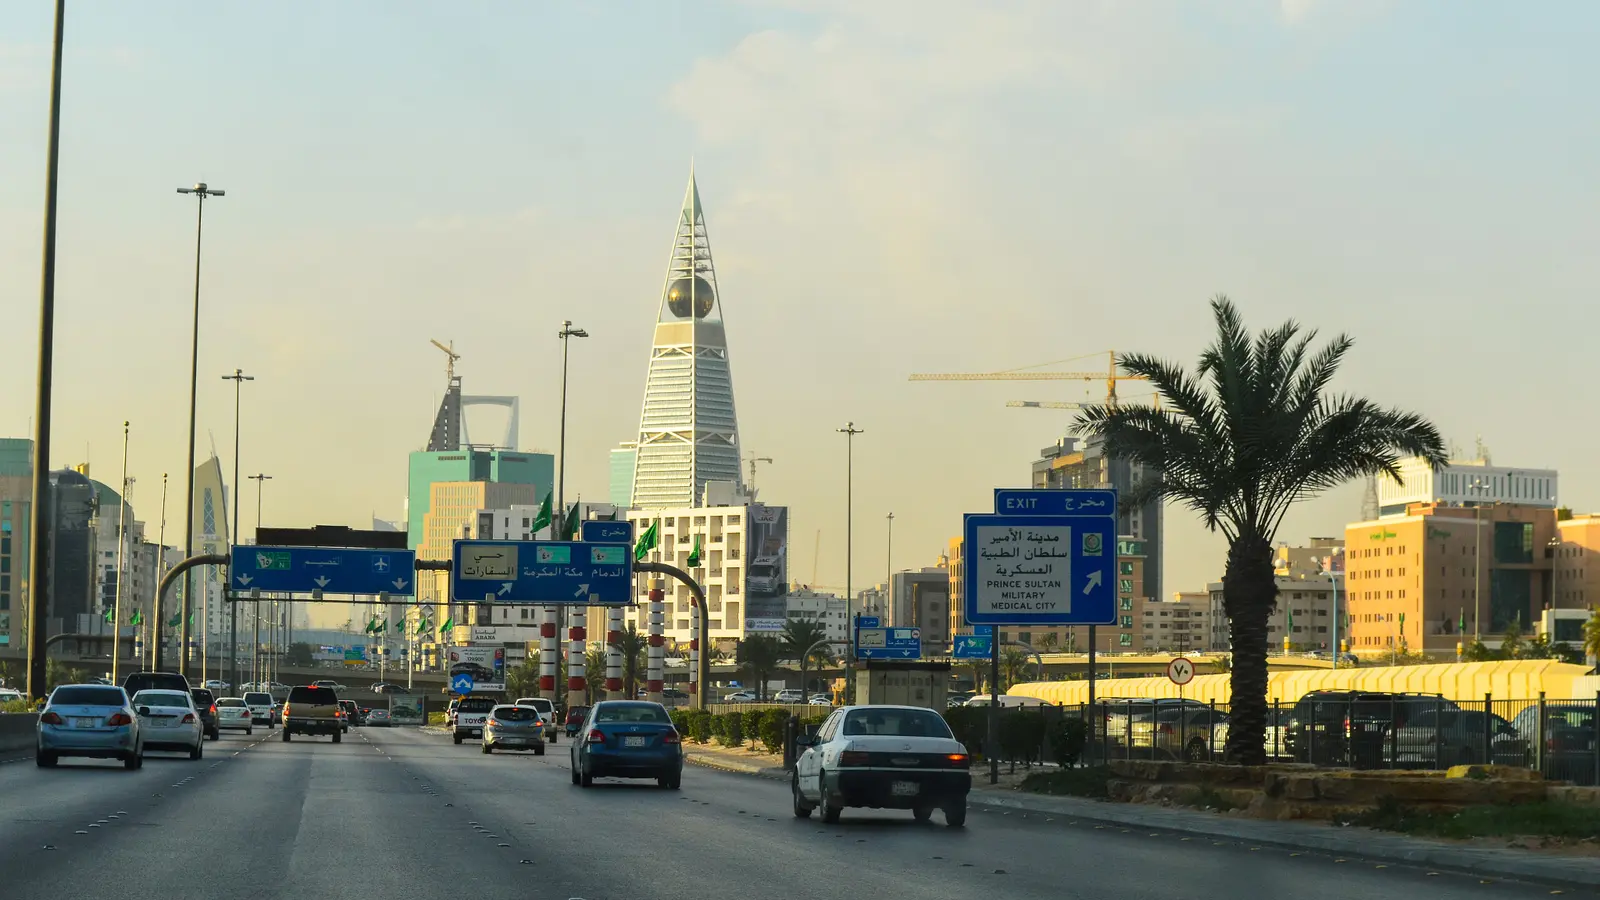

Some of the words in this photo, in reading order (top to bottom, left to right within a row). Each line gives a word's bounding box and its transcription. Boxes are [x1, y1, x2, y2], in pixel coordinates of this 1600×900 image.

[1006, 498, 1038, 509] EXIT
[1065, 497, 1105, 510] مخرج
[601, 527, 626, 536] مخرج
[989, 528, 1022, 544] الأمير
[1026, 531, 1060, 544] مدينة
[474, 552, 504, 563] حي
[980, 547, 1020, 560] الطبية
[1024, 547, 1068, 560] سلطان
[464, 565, 514, 577] السفارات
[523, 566, 561, 578] المكرمة
[564, 567, 583, 577] مكة
[591, 567, 624, 578] الدمام
[995, 564, 1053, 577] العسكرية
[986, 580, 1021, 588] PRINCE
[1024, 580, 1061, 588] SULTAN
[990, 602, 1033, 610] MEDICAL
[1035, 602, 1057, 610] CITY
[1174, 664, 1189, 678] ٧٠
